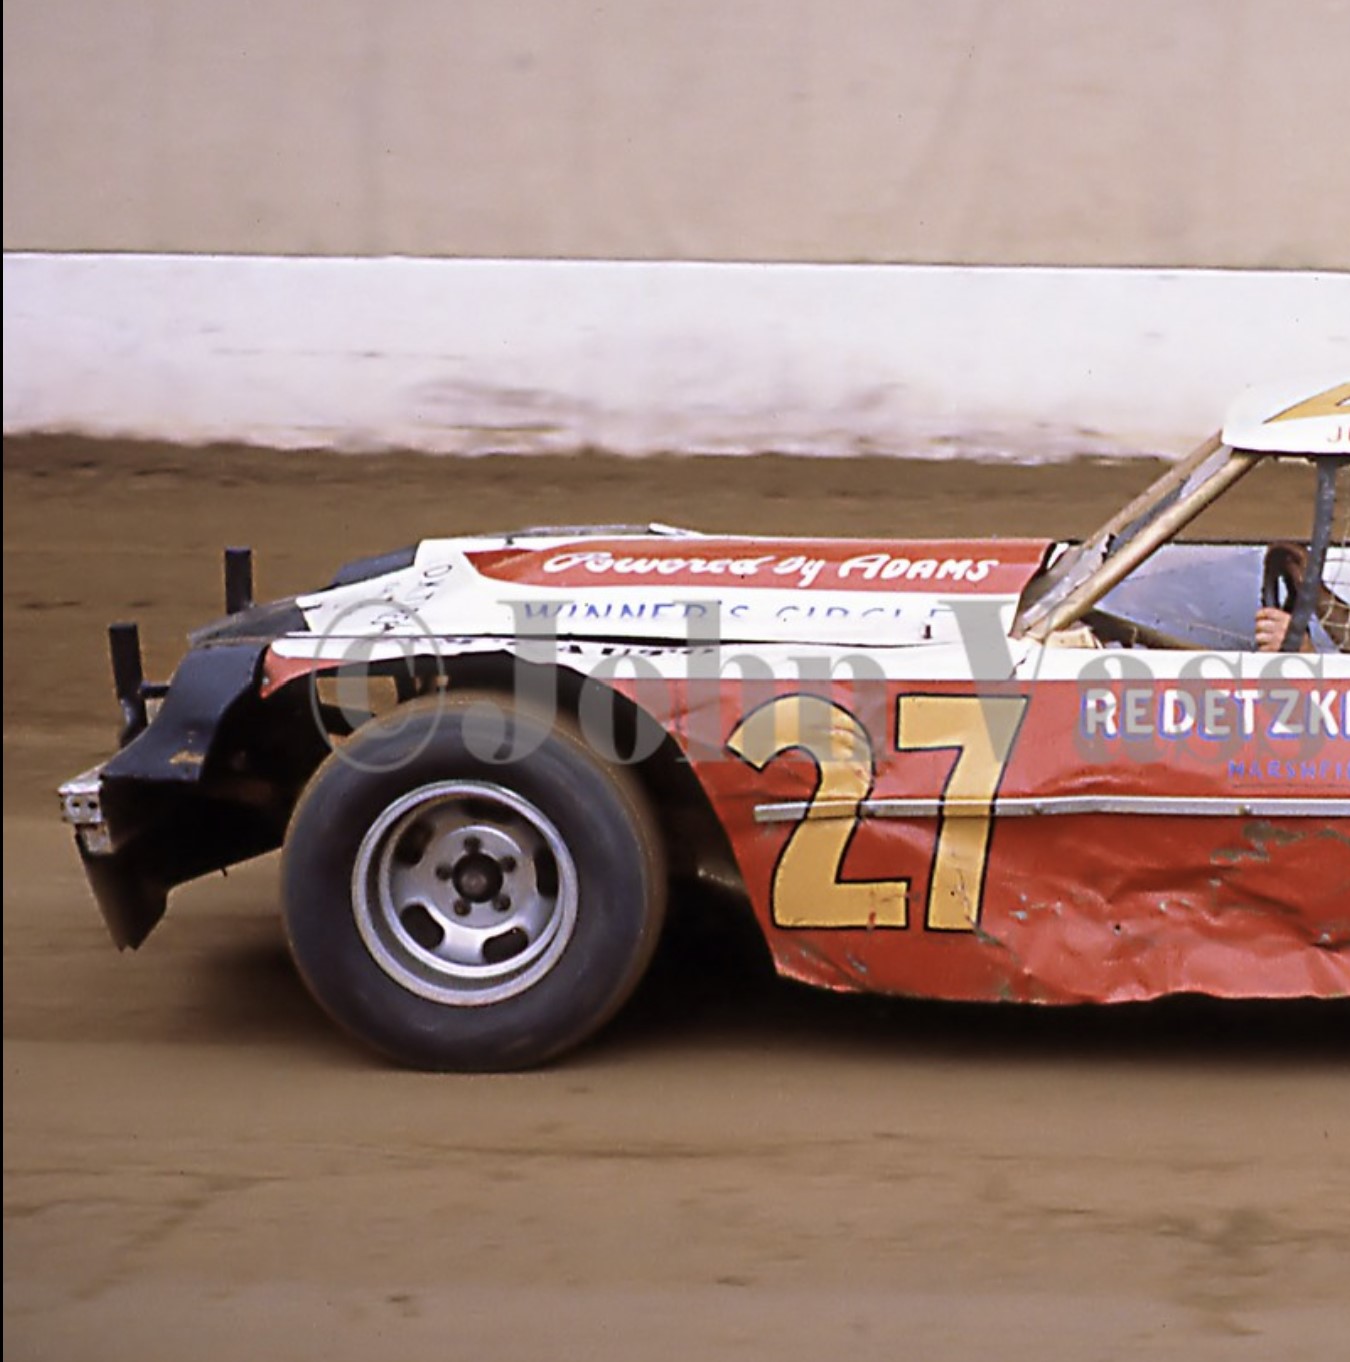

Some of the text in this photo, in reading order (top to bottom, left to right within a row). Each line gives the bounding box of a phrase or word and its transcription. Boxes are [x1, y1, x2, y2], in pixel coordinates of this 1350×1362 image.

[543, 551, 999, 588] Powered by ADAMS
[726, 692, 1030, 933] 27
